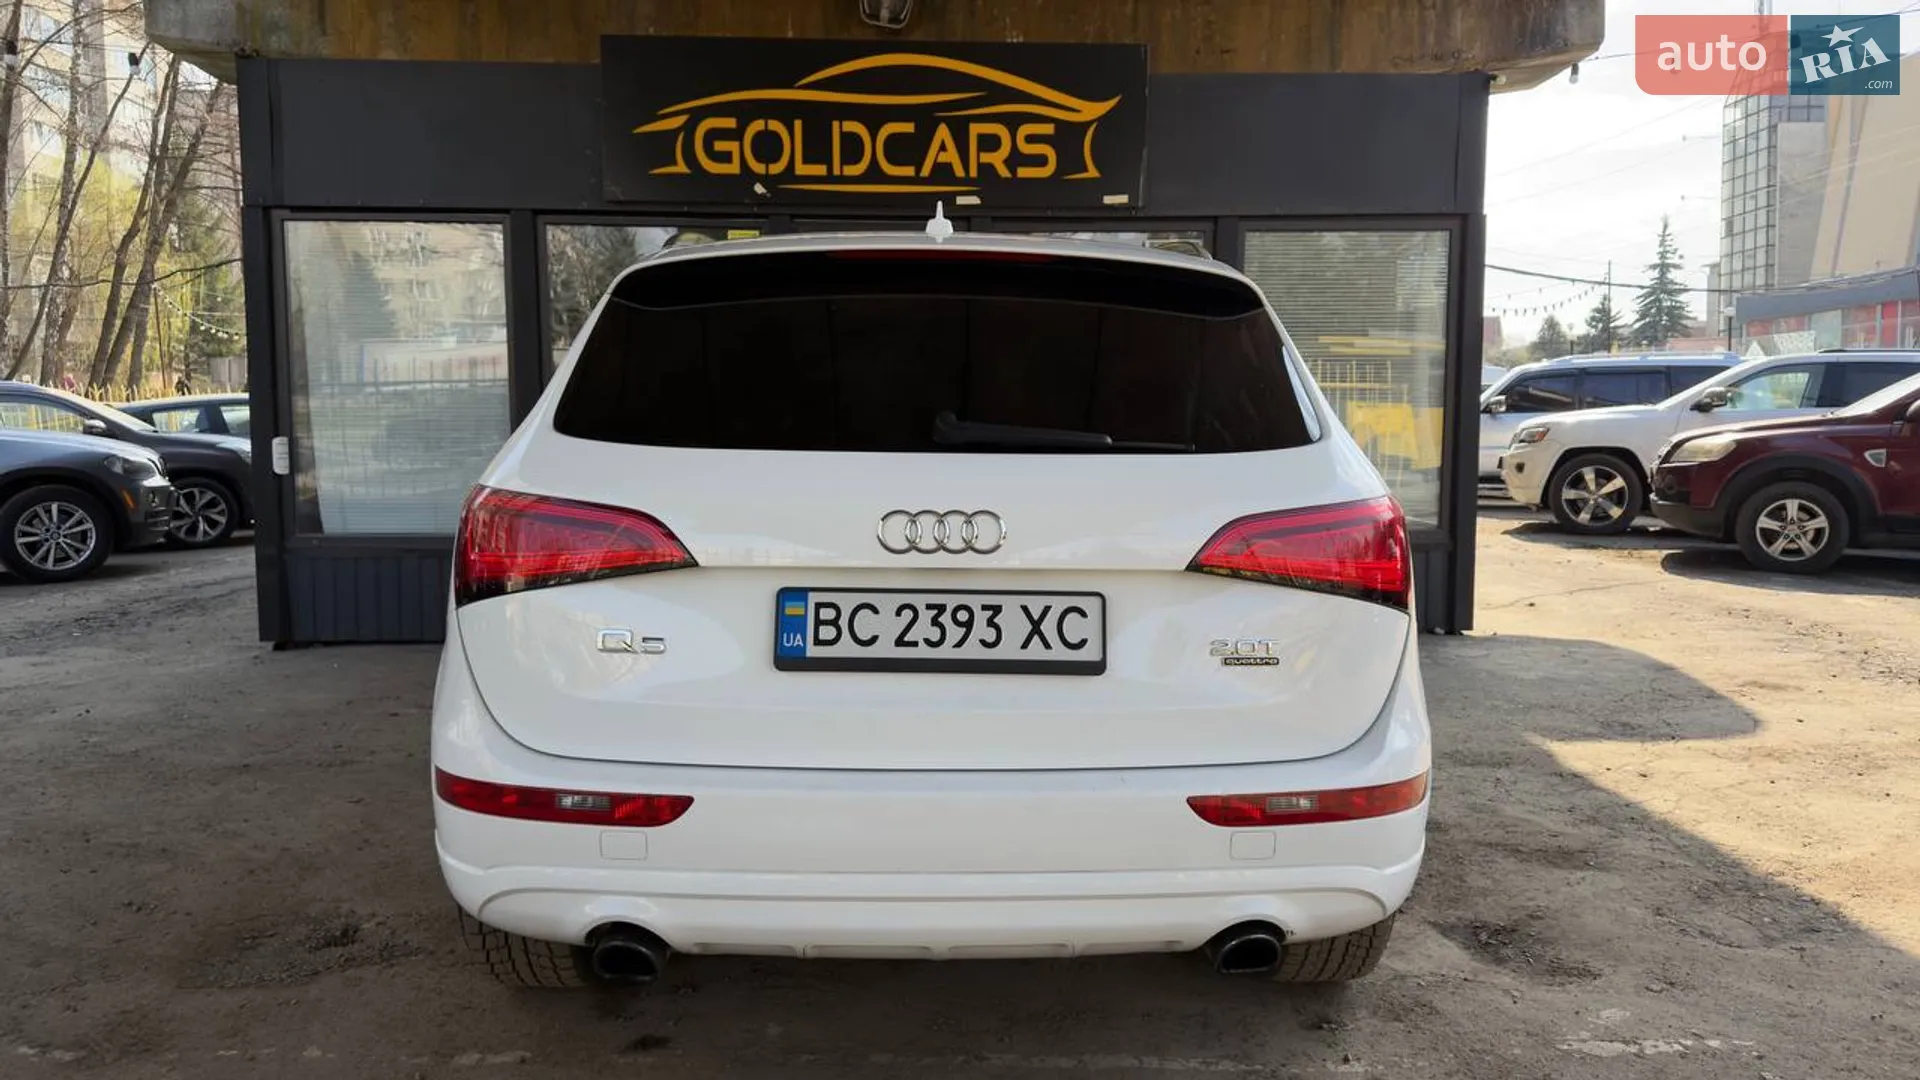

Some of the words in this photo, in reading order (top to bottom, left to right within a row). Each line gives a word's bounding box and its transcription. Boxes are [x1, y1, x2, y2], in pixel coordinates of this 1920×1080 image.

[694, 116, 1058, 178] GOLDCARS
[812, 601, 880, 648] BC
[894, 603, 1003, 649] 2393
[1020, 604, 1089, 651] XC
[597, 628, 667, 655] Q5
[783, 632, 804, 647] UA
[1209, 638, 1280, 656] 2.0T
[1223, 657, 1279, 666] quattro
